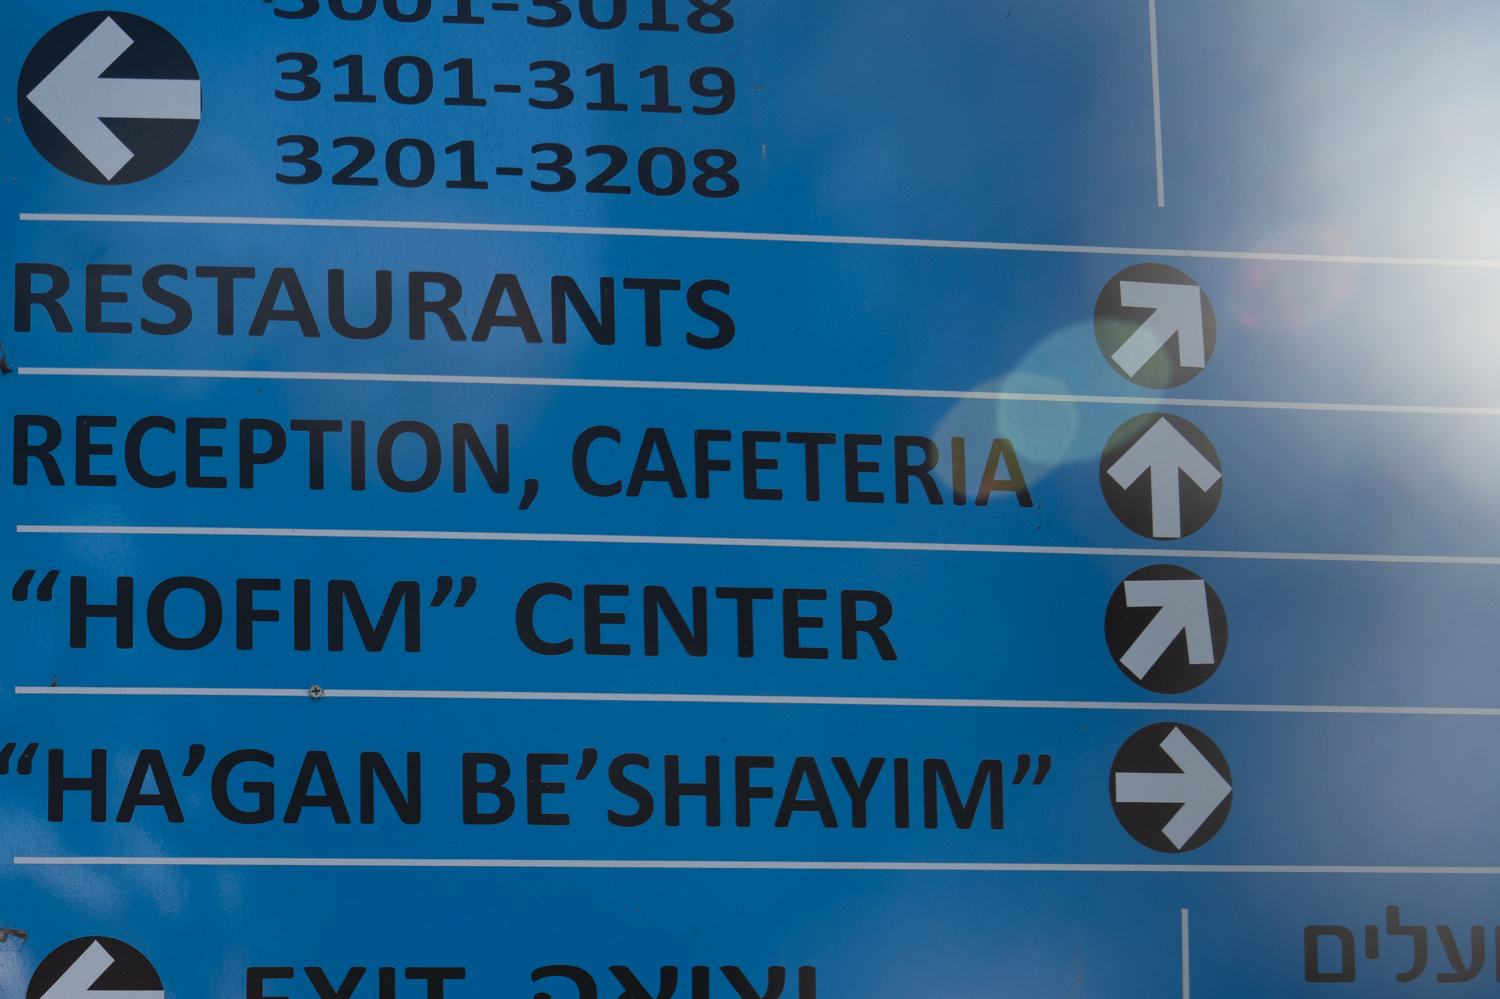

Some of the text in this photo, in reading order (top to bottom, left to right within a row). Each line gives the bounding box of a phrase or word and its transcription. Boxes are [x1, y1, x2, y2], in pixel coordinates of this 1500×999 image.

[275, 52, 736, 115] 3101-3119
[276, 135, 740, 198] 3201-3208
[14, 263, 736, 350] RESTAURANTS
[13, 414, 1034, 510] RECEPTION, CAFETERIA
[11, 569, 898, 661] “HOFIM” CENTER
[461, 748, 1052, 830] BE’SHFAYIM”
